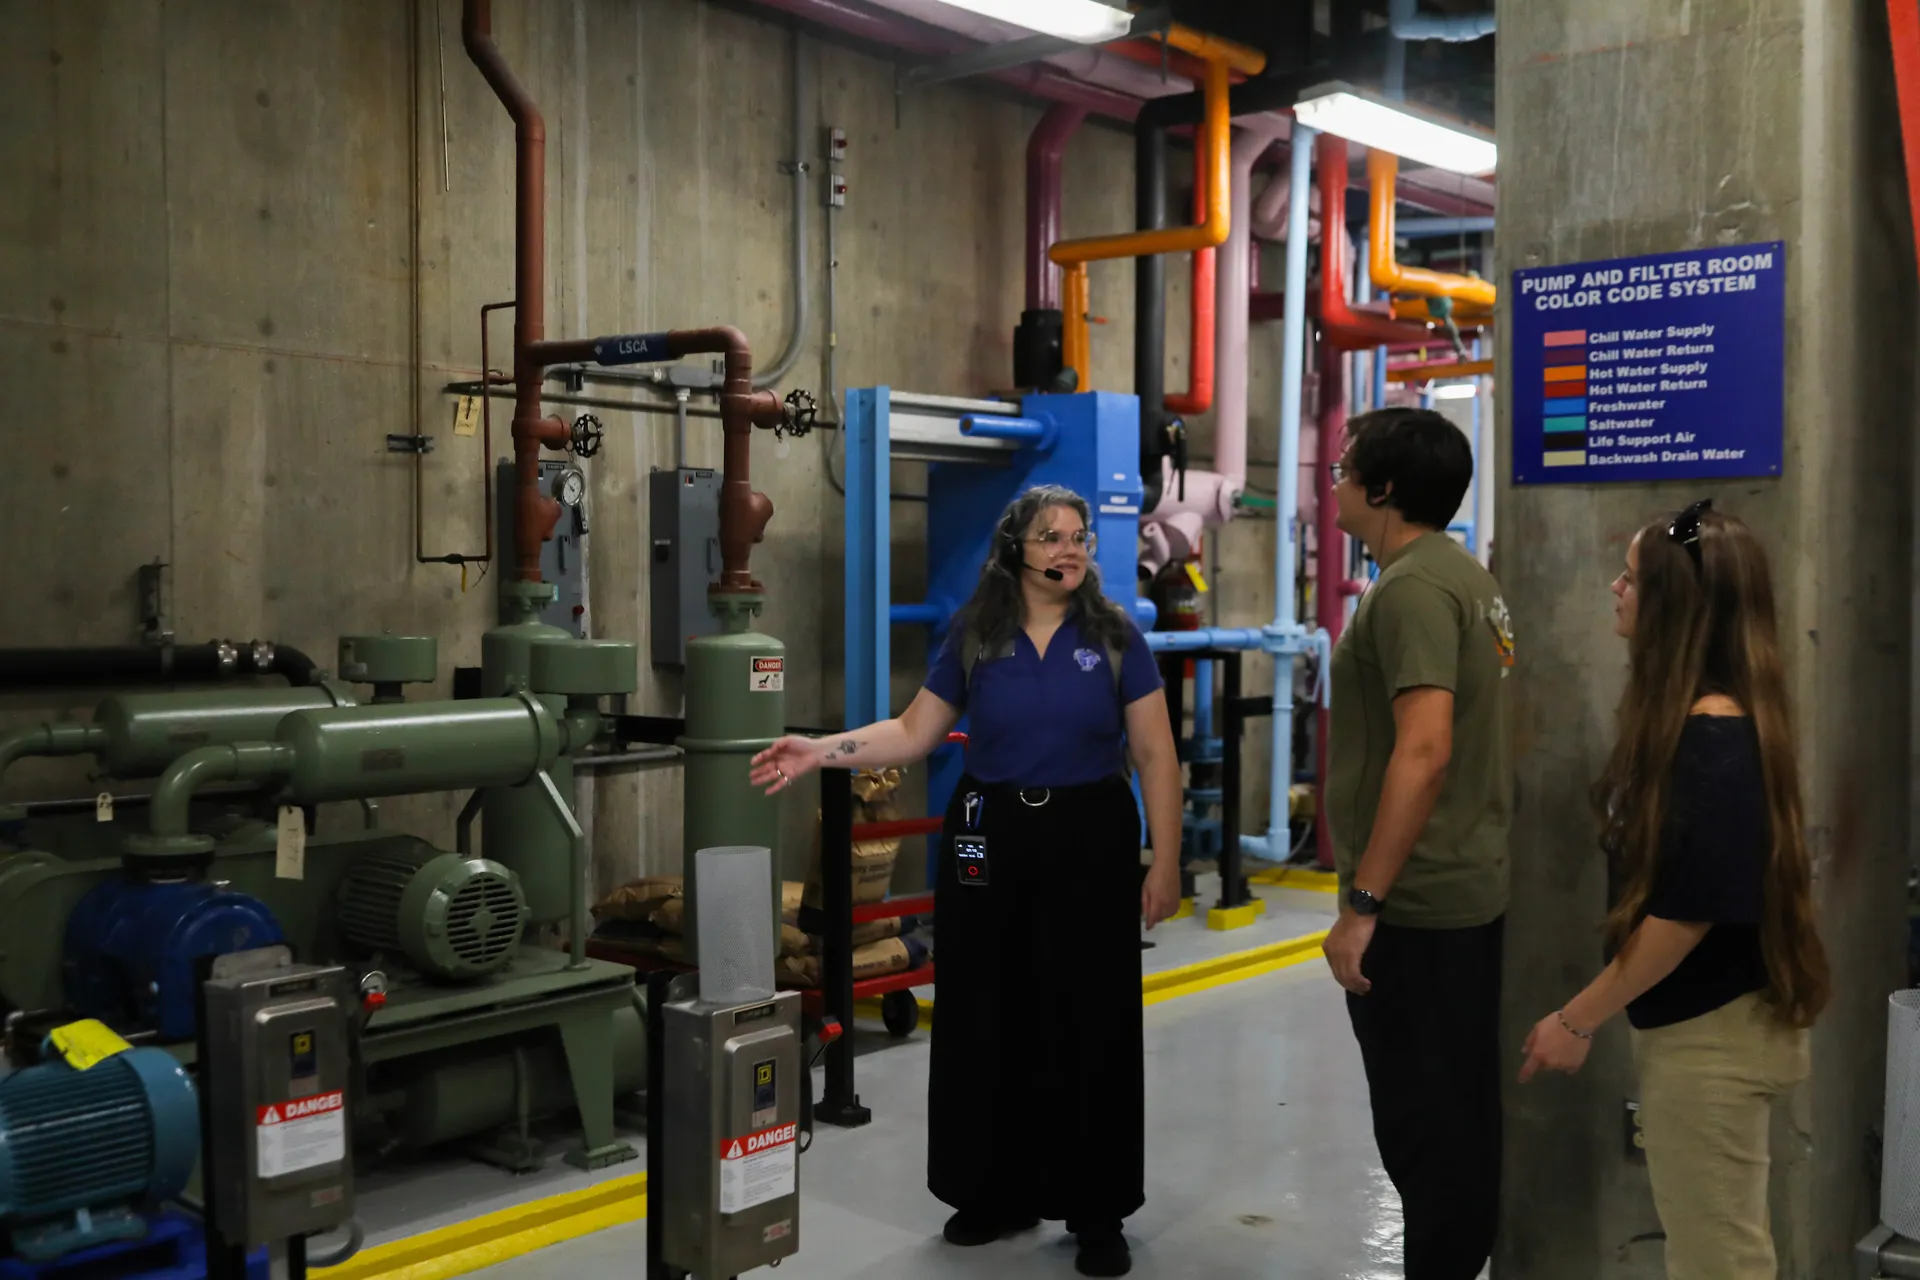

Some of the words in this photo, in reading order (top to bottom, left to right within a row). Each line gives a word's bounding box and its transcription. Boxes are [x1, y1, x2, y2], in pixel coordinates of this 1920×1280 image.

[1522, 275, 1576, 294] PUMP
[1581, 269, 1623, 287] AND
[1629, 261, 1701, 283] FILTER
[1708, 253, 1772, 274] ROOM
[1535, 292, 1601, 310] COLOR
[1607, 283, 1663, 303] CODE
[1667, 274, 1755, 297] SYSTEM
[1589, 331, 1619, 344] Chill
[1623, 329, 1663, 340] Water
[1667, 323, 1714, 338] Supply
[619, 340, 648, 354] LSCA
[1589, 350, 1619, 362] Chill
[1623, 348, 1663, 359] Water
[1667, 343, 1714, 356] Return
[1589, 368, 1613, 379] Hot
[1617, 366, 1657, 377] Water
[1660, 360, 1707, 375] Supply
[1589, 385, 1613, 395] Hot
[1616, 383, 1656, 393] Water
[1660, 379, 1707, 391] Return
[1589, 399, 1665, 412] Freshwater
[1589, 417, 1654, 431] Saltwater
[1589, 436, 1614, 447] Life
[1618, 433, 1671, 447] Support
[1675, 432, 1695, 443] Air
[1589, 452, 1657, 465] Backwash
[1662, 450, 1699, 462] Drain
[1702, 449, 1745, 460] Water
